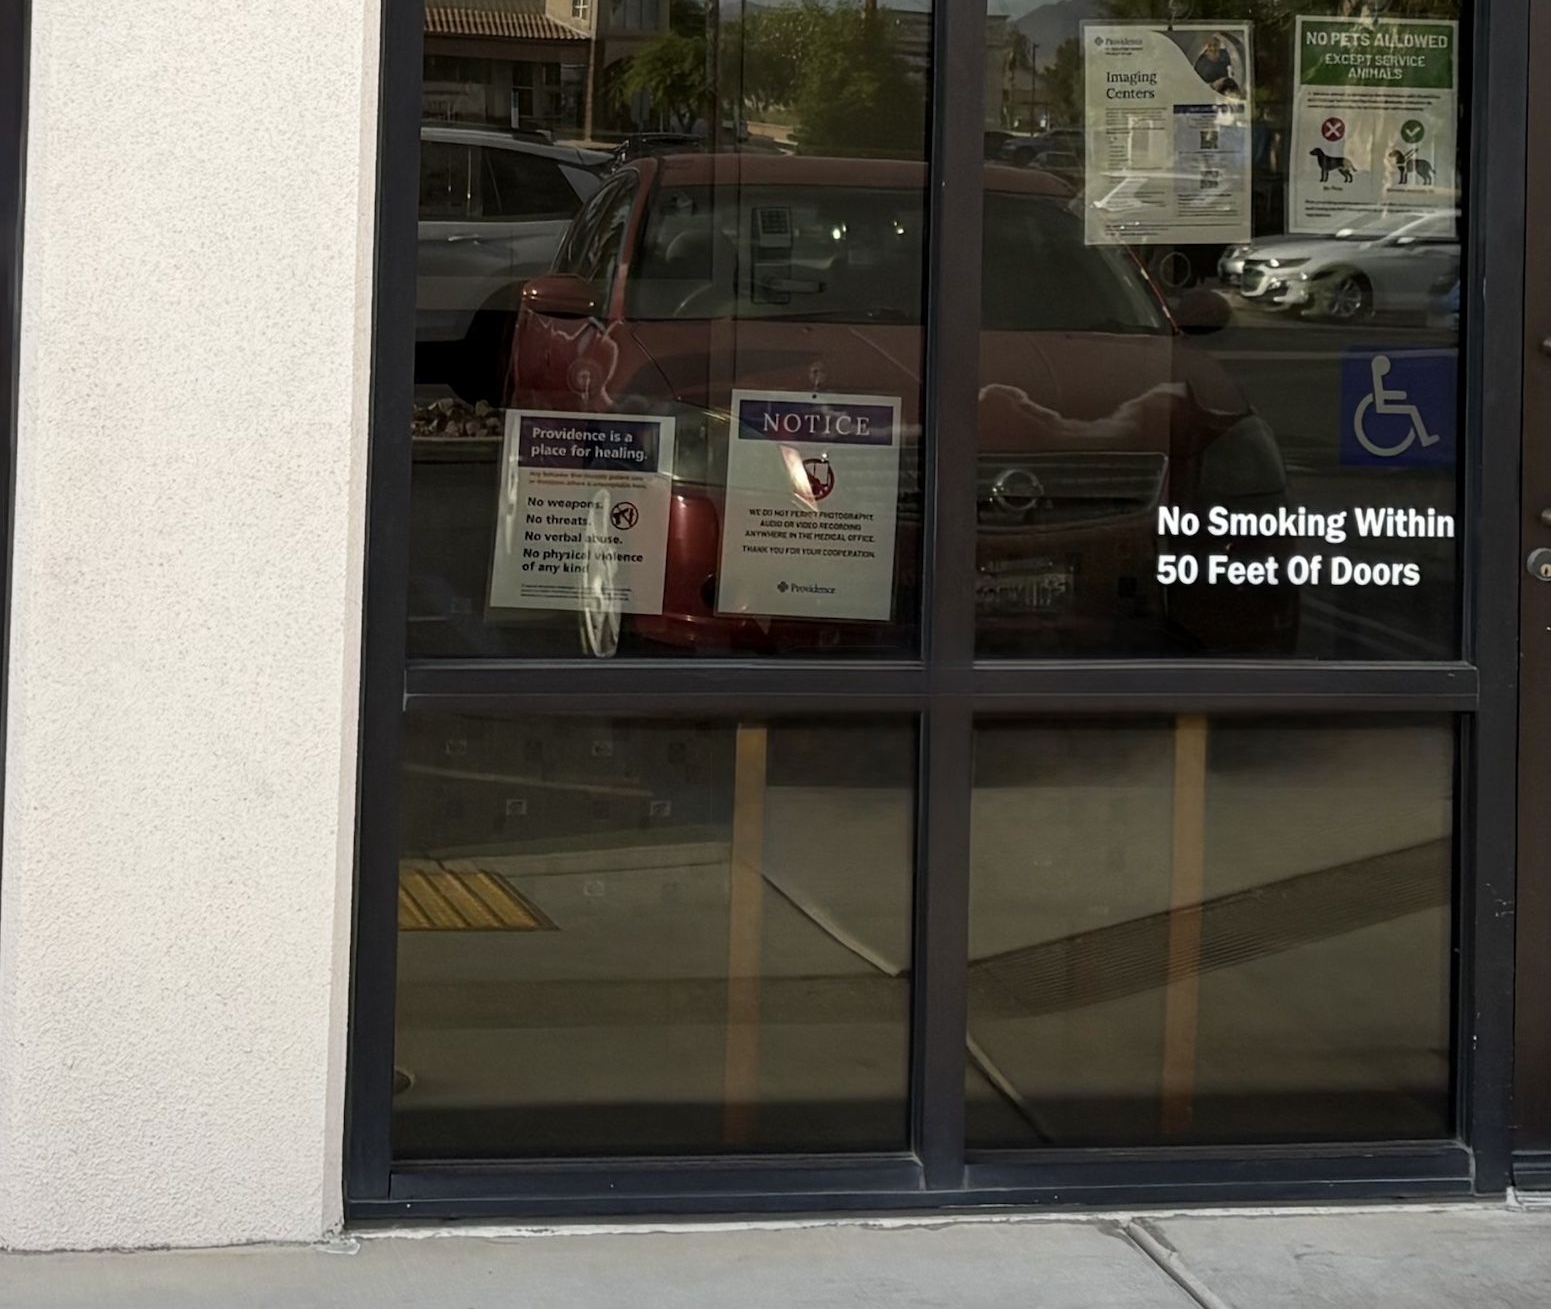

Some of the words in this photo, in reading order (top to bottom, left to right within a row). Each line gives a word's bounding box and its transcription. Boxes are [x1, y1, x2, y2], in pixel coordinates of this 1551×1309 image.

[1306, 32, 1327, 45] NO
[1331, 32, 1370, 47] PETS
[1374, 33, 1448, 48] ALLOWED
[1325, 53, 1371, 65] EXCEPT
[1375, 55, 1426, 67] SERVICE
[1106, 71, 1157, 85] Imaging
[1349, 67, 1402, 79] ANIMALS
[1106, 88, 1155, 99] Centers
[763, 413, 870, 435] NOTICE
[532, 427, 606, 441] Providence
[610, 431, 620, 442] is
[624, 434, 632, 443] a
[531, 444, 566, 457] place
[571, 445, 591, 457] for
[594, 446, 647, 462] healing.
[528, 497, 544, 507] No
[548, 499, 604, 510] weapons.
[526, 515, 542, 524] No
[546, 515, 591, 525] threats.
[820, 522, 861, 531] RECORDING
[1157, 505, 1200, 536] No
[1207, 505, 1348, 544] Smoking
[1353, 507, 1455, 538] Within
[525, 531, 541, 541] No
[544, 532, 581, 542] verbal
[585, 535, 622, 544] abuse.
[799, 532, 812, 540] THE
[814, 533, 846, 541] MEDICAL
[523, 549, 539, 558] No
[543, 549, 590, 561] physical
[594, 550, 643, 562] violence
[742, 545, 768, 553] THANK
[786, 547, 800, 555] FOR
[522, 562, 535, 571] of
[538, 563, 560, 574] any
[1156, 554, 1199, 585] 50
[1208, 554, 1279, 585] Feet
[1286, 554, 1323, 586] Of
[1330, 555, 1421, 586] Doors
